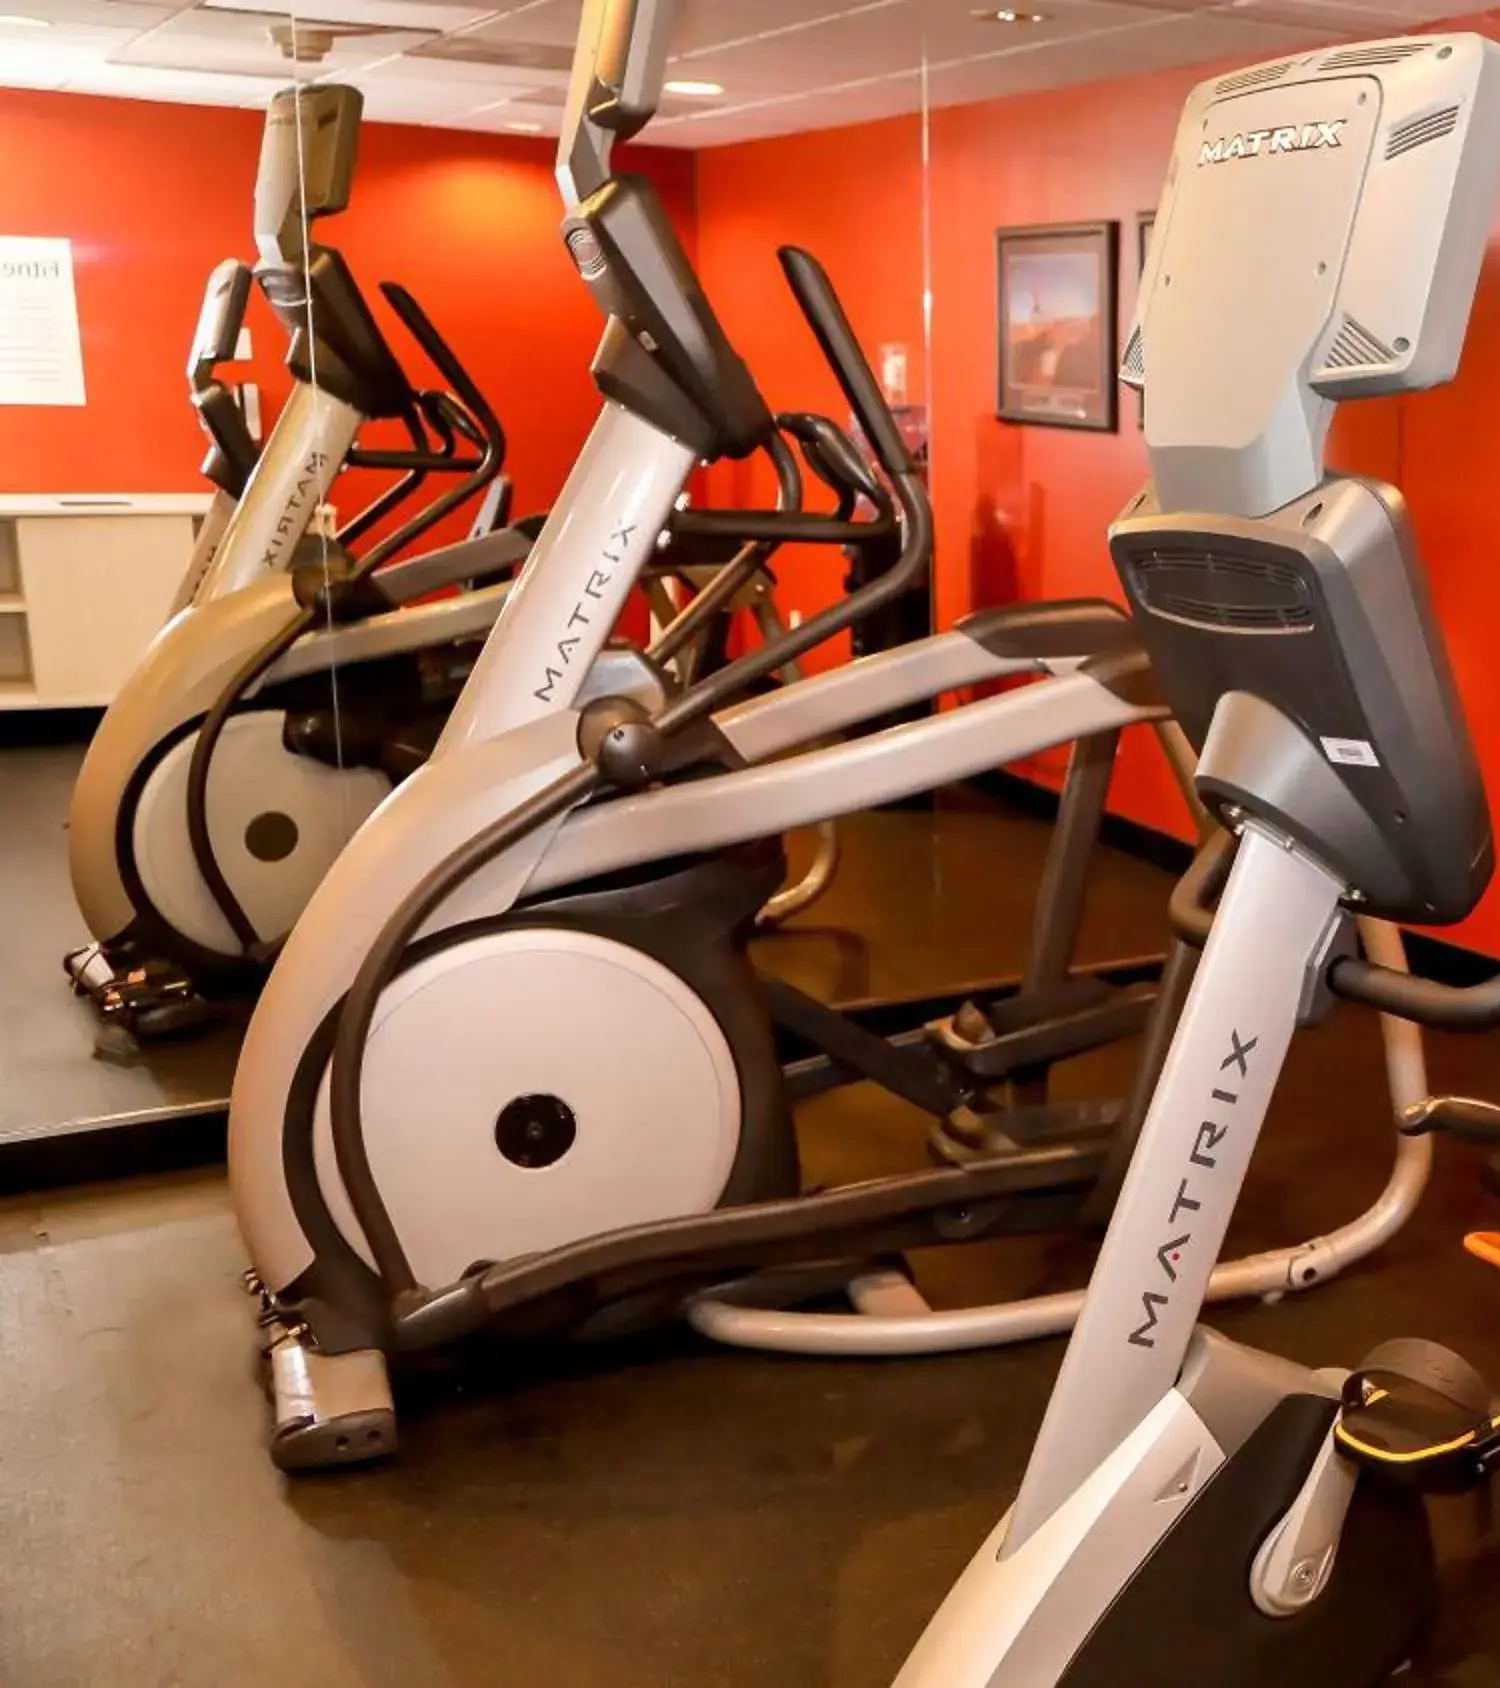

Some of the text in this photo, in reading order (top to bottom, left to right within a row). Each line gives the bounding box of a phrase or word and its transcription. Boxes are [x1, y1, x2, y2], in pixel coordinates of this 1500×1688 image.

[1198, 119, 1347, 167] MATRIX
[532, 518, 637, 702] MATRIX
[1127, 1027, 1260, 1348] MATRIX
